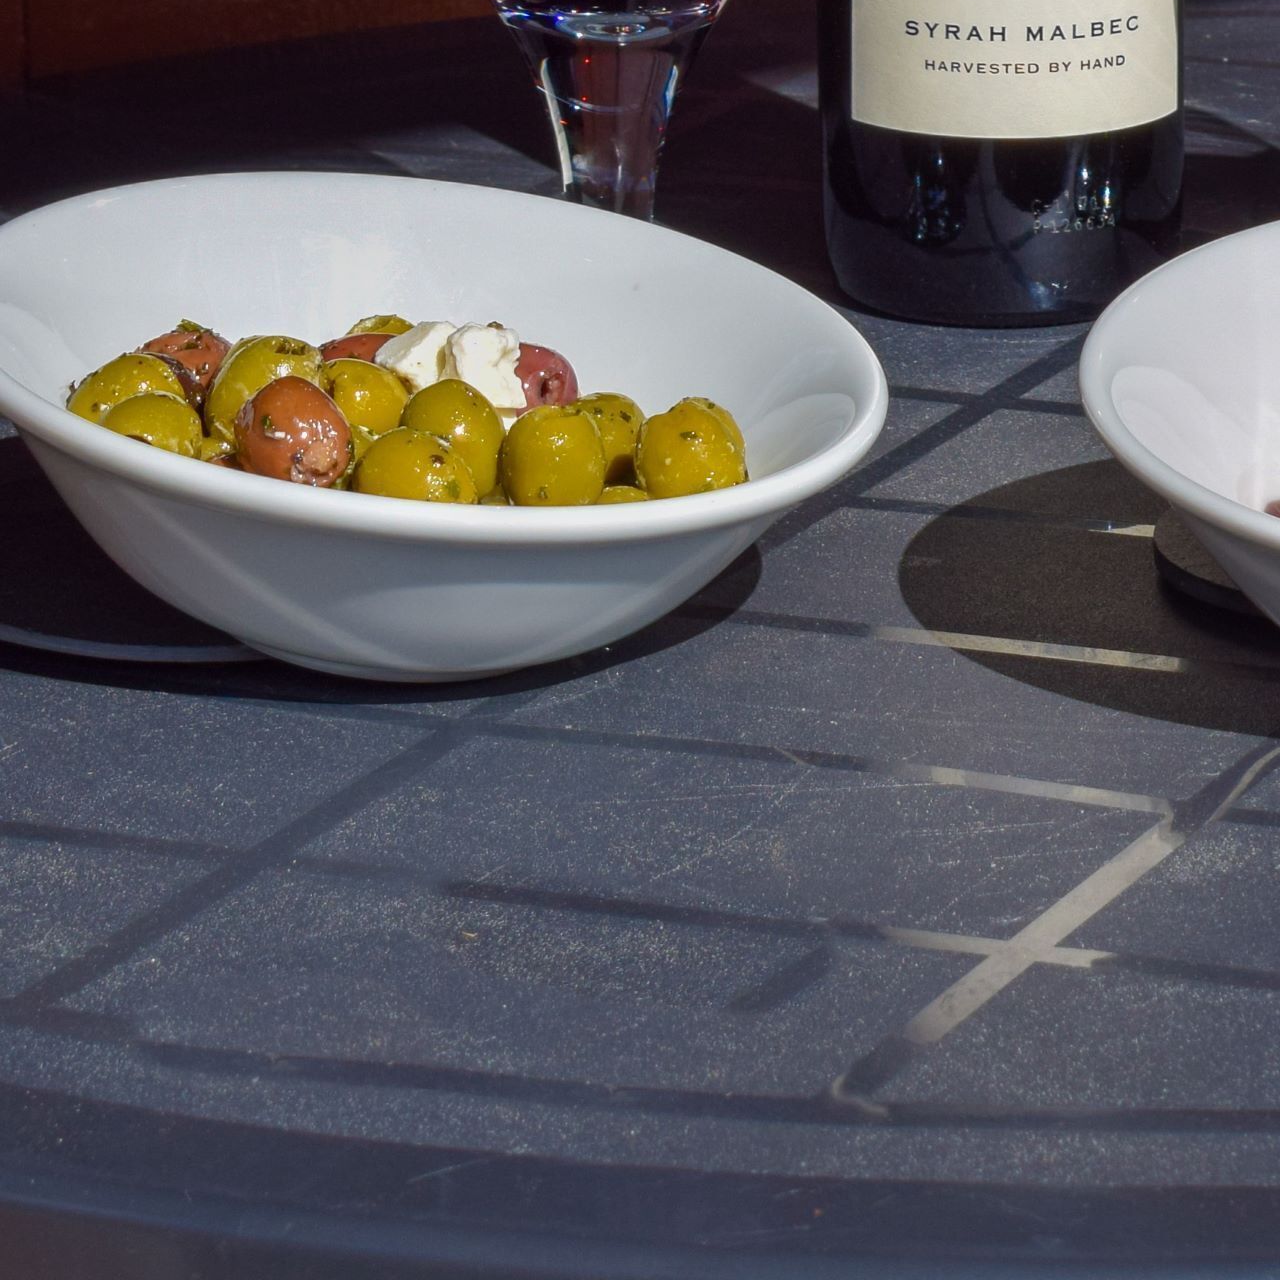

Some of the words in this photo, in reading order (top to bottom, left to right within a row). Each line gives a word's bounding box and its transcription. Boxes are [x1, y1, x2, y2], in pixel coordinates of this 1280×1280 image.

[904, 20, 1007, 43] SYRAH
[1025, 15, 1140, 42] MALBEC
[924, 59, 1040, 75] HARVESTED
[1048, 60, 1073, 74] BY
[1080, 54, 1127, 71] HAND
